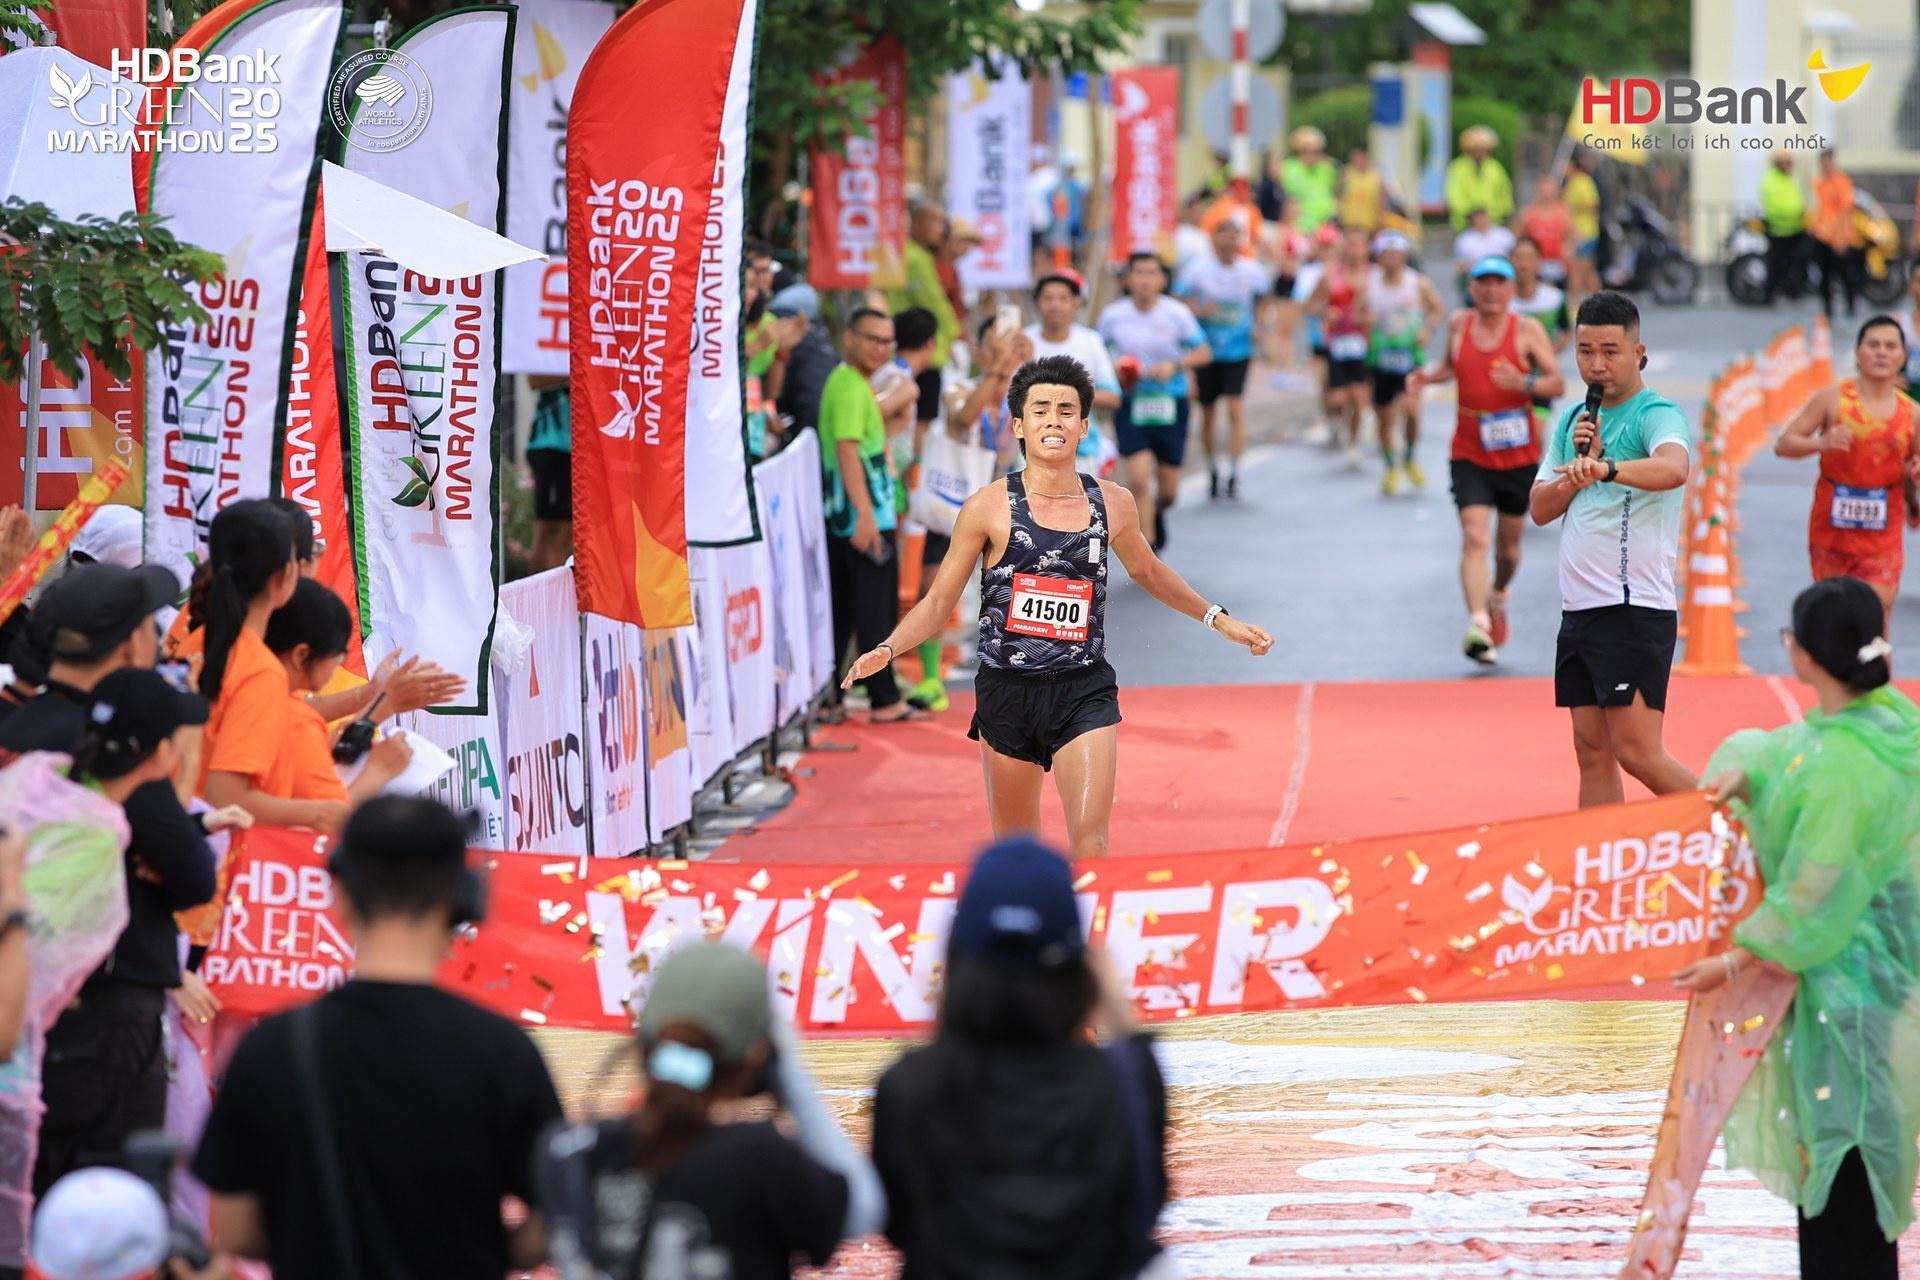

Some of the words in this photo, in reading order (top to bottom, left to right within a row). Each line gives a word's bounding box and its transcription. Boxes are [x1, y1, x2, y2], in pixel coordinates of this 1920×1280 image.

[615, 179, 648, 239] 20
[838, 78, 879, 275] HDBa
[646, 186, 684, 242] 25
[586, 177, 621, 369] HDBank
[226, 278, 260, 352] 25
[362, 252, 412, 432] HDBan
[643, 246, 677, 446] MARATHON
[216, 360, 250, 508] ATHON
[445, 304, 483, 520] MARATHON
[1616, 546, 1629, 582] Unique
[1013, 623, 1048, 633] MARATHON
[1022, 597, 1080, 623] 41500
[508, 732, 586, 852] SUUNTO
[227, 860, 334, 910] HDB
[210, 904, 357, 960] REEN
[585, 877, 1342, 1024] WINER
[1494, 915, 1704, 968] MARATHON
[204, 955, 357, 991] RATHON
